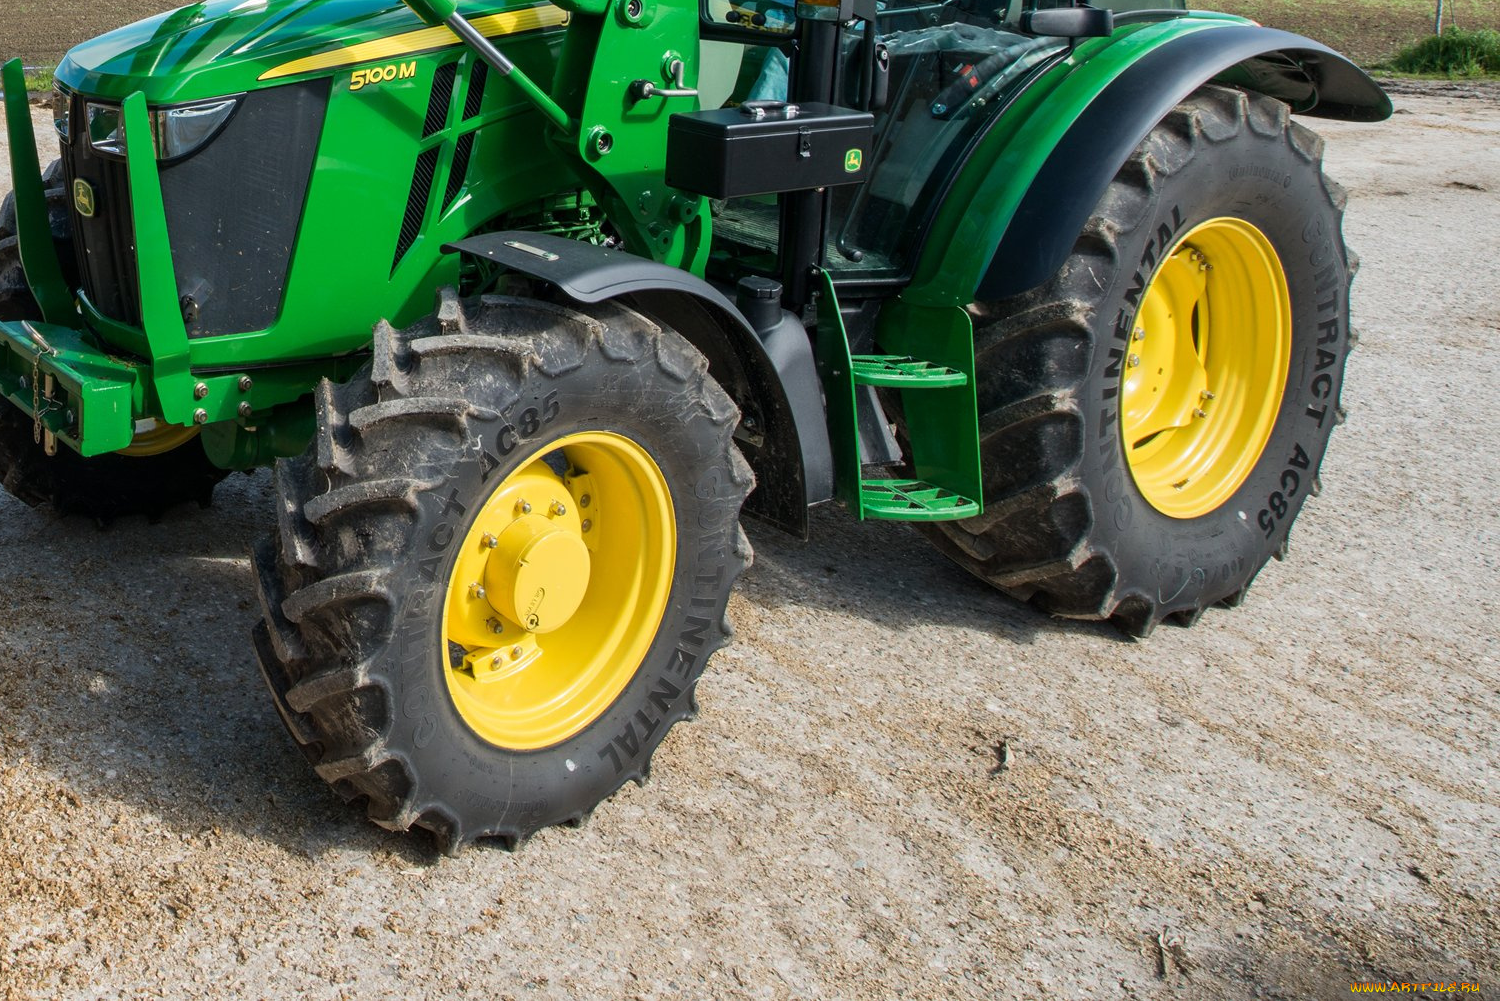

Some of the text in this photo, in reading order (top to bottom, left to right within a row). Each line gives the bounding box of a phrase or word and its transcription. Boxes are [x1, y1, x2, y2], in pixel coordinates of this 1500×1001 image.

[349, 61, 417, 91] 5100 M
[1100, 205, 1187, 531] CONTINENTAL
[1257, 213, 1340, 540] CONTRACT AC85
[399, 388, 560, 748] CONTRACT AC85
[597, 465, 726, 774] CONTINENTAL
